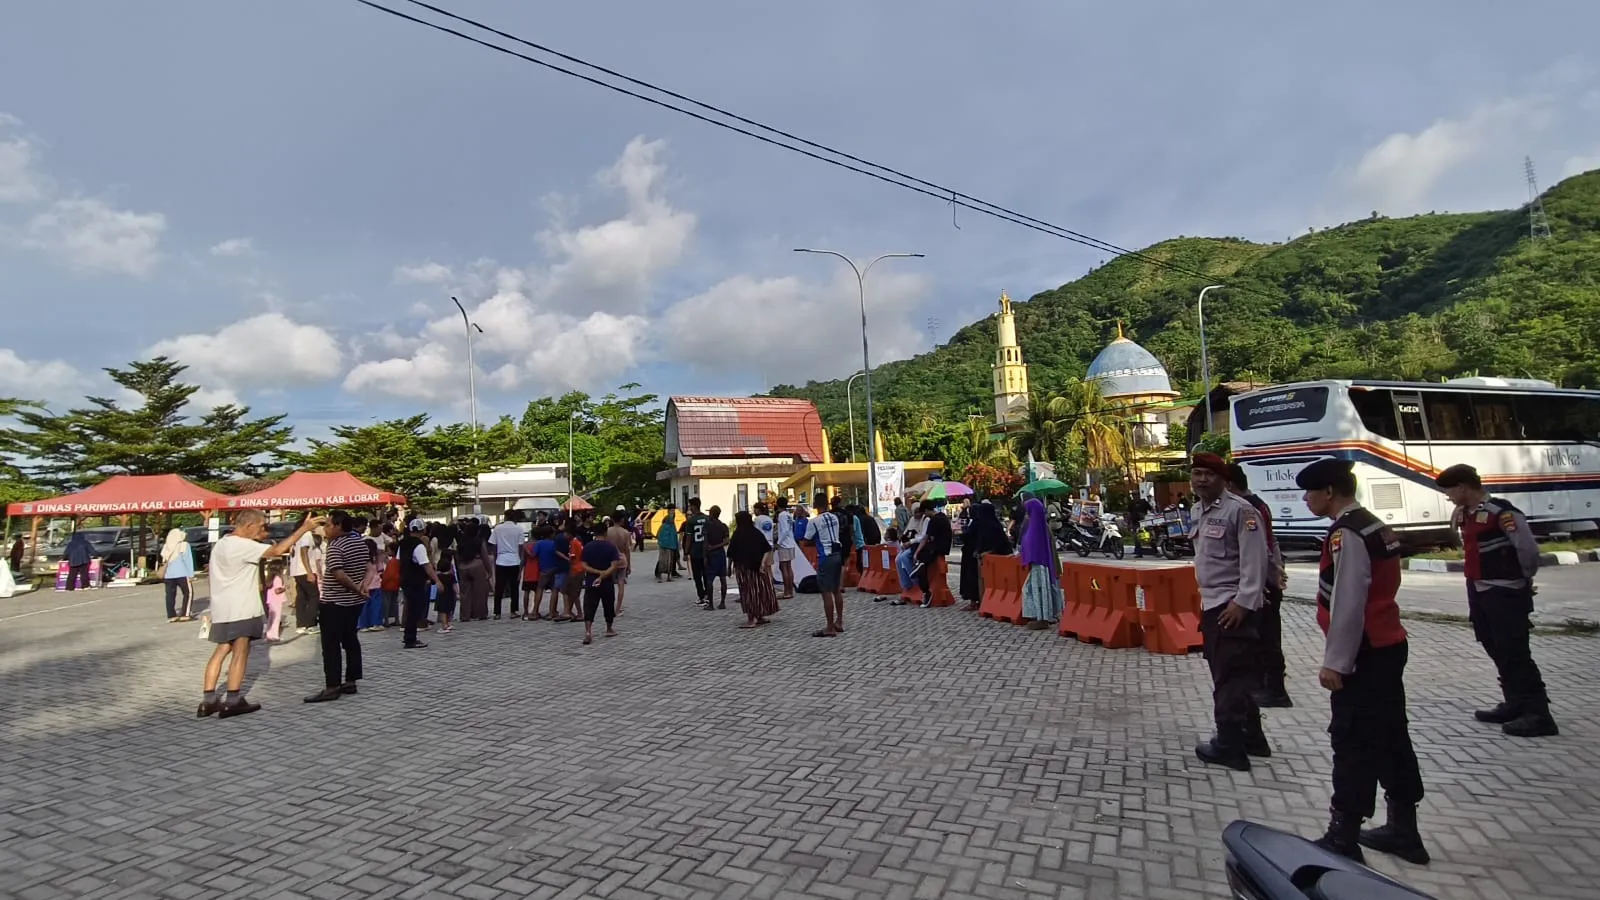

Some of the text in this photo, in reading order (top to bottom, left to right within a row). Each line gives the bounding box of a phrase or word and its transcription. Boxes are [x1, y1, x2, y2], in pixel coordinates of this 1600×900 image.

[1264, 468, 1297, 482] Trilok
[36, 499, 205, 513] DINAS PARIWISATA KAB. LOBAR
[240, 493, 380, 507] DINAS PARIWISATA KAB. LOBAR
